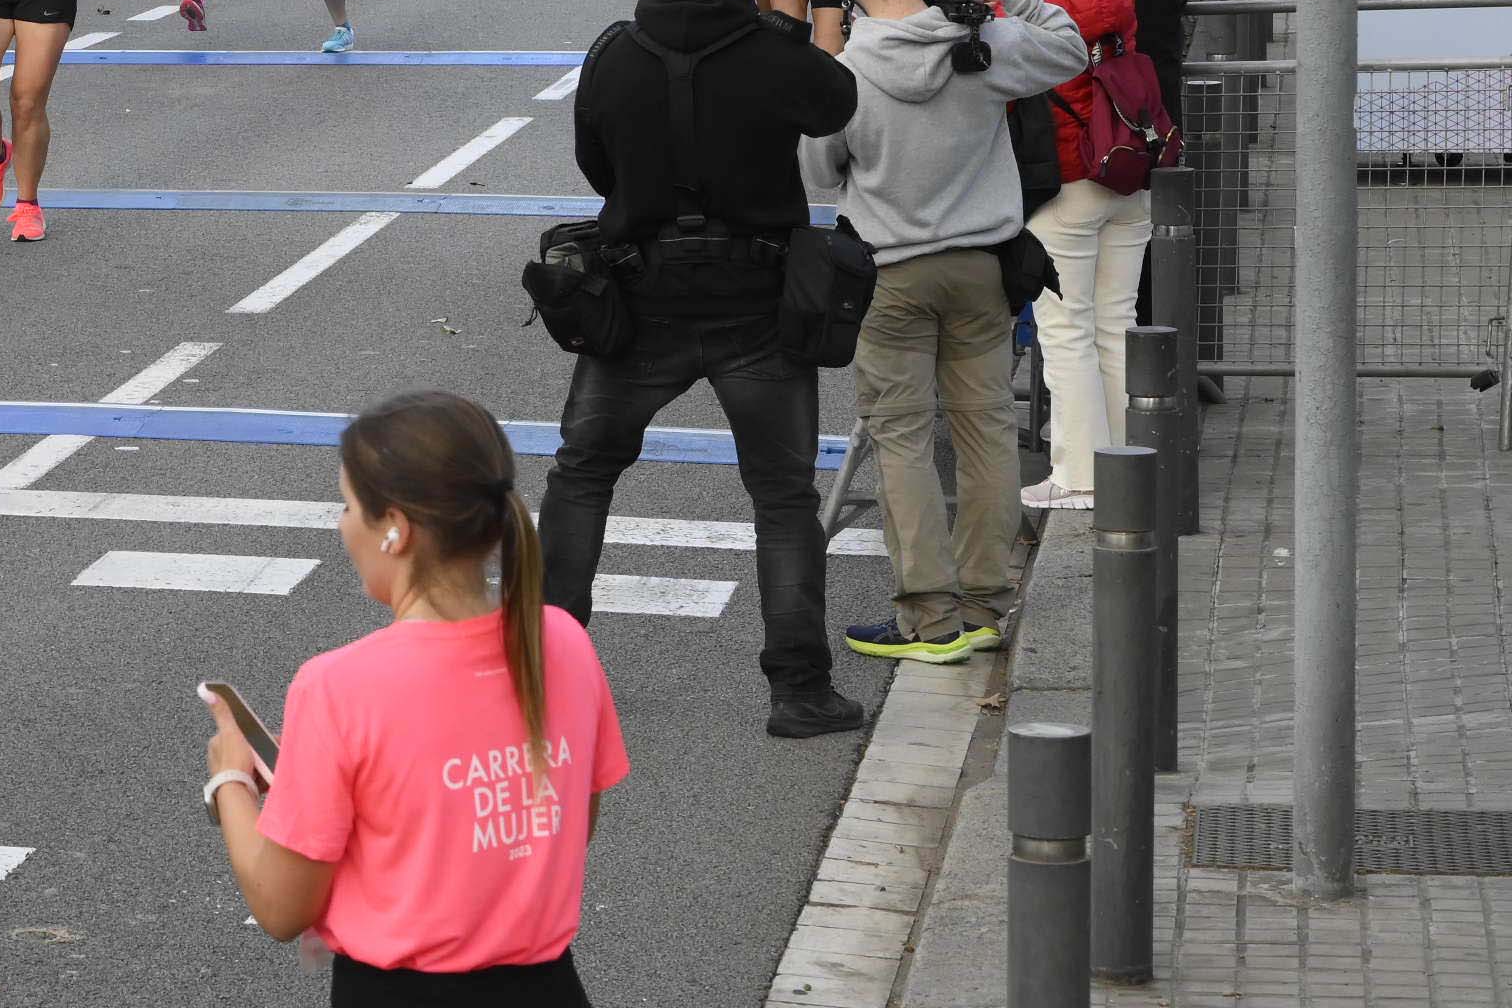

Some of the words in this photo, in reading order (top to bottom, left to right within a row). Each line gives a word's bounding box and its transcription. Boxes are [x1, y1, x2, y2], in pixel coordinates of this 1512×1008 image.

[473, 780, 512, 818] DE
[520, 773, 559, 807] LA
[471, 804, 562, 853] MUJER
